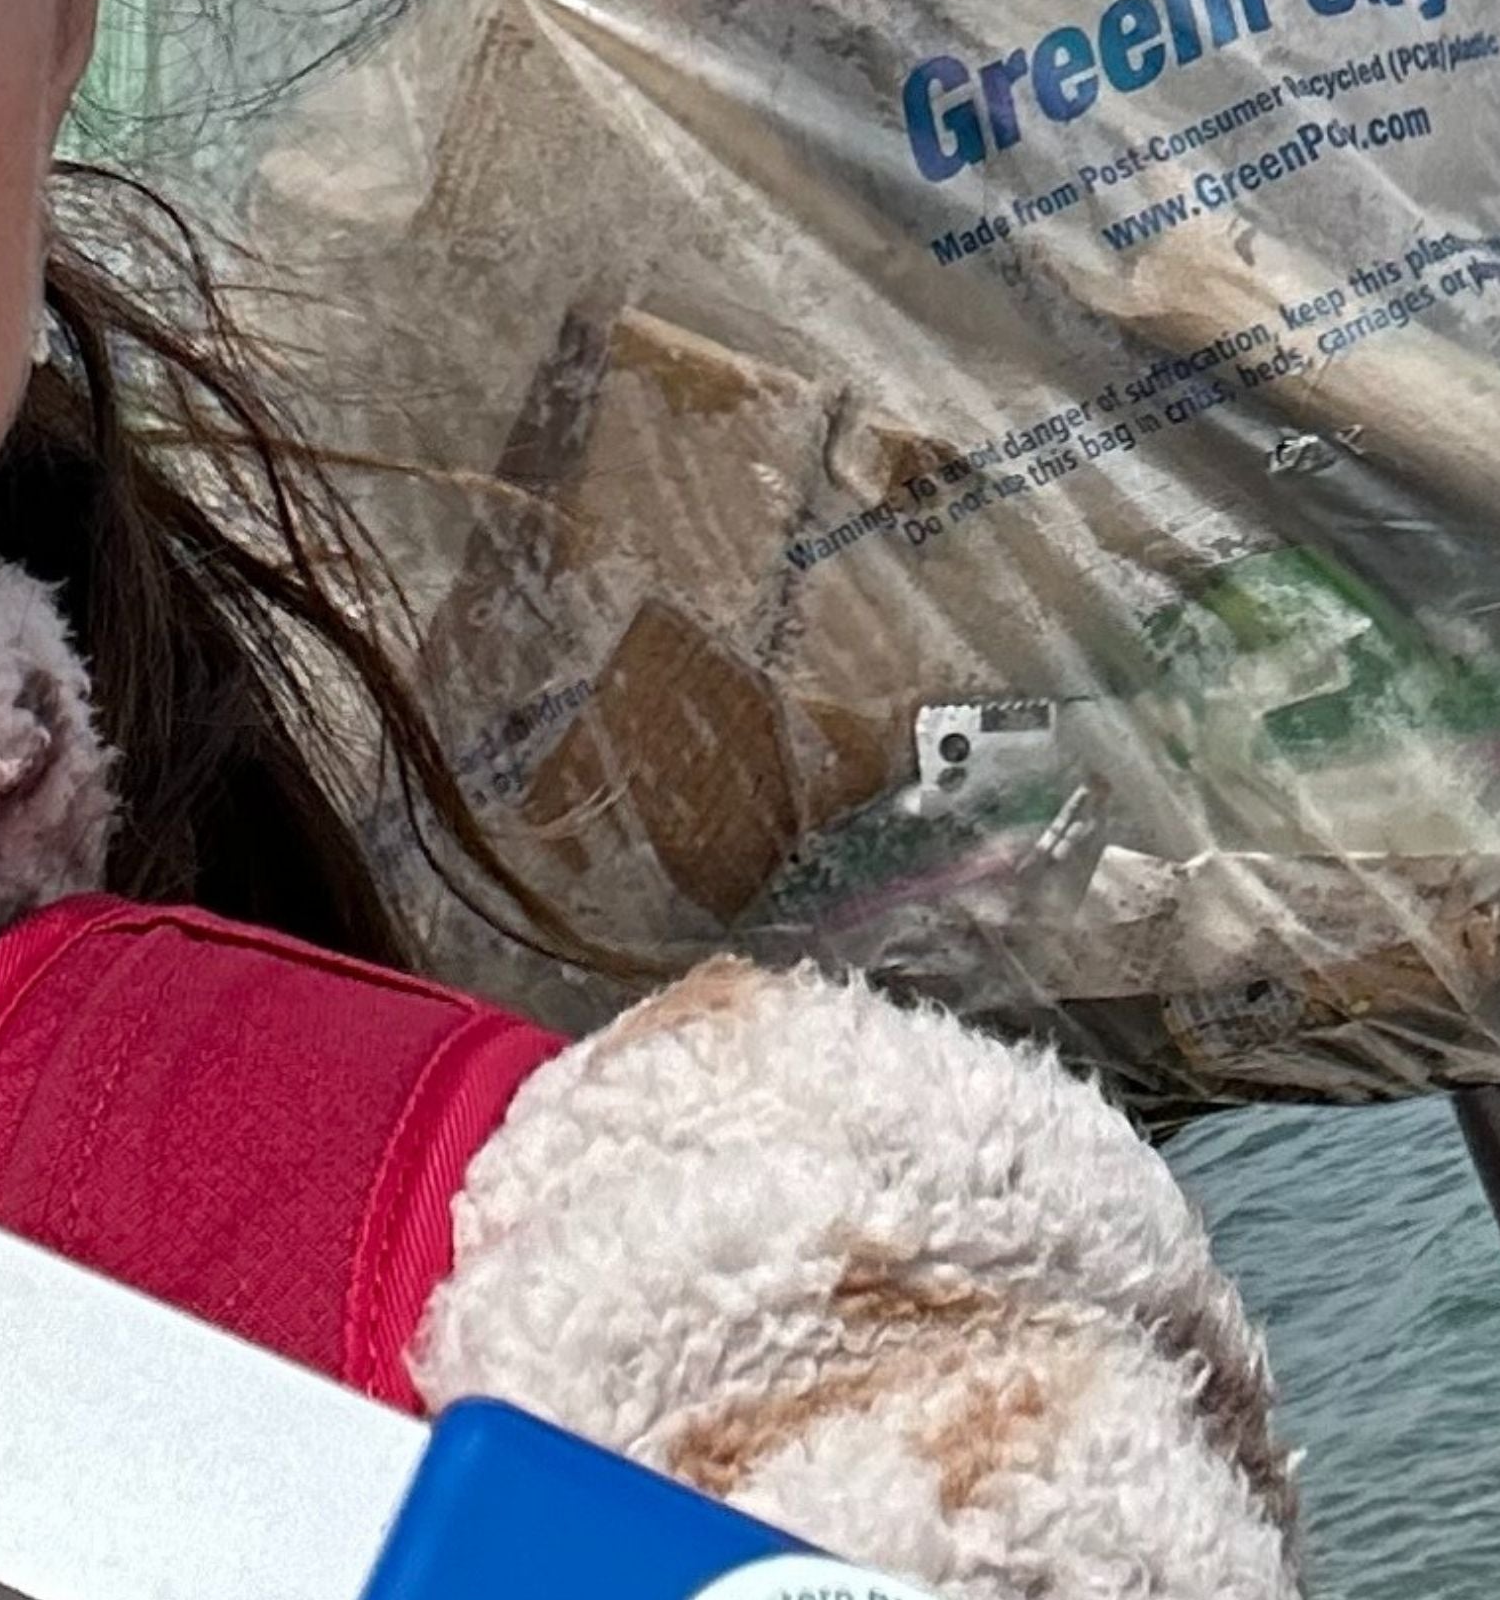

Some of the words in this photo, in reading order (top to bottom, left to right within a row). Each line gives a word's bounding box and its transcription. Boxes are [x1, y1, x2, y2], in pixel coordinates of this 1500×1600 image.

[931, 214, 1012, 267] Made
[1011, 182, 1080, 228] from
[1078, 83, 1284, 195] Post-Consumer
[903, 473, 938, 506] To
[940, 440, 1000, 485] avoid
[1002, 400, 1093, 461] danger
[1096, 384, 1123, 413] of
[1278, 287, 1346, 331] keep
[1349, 259, 1401, 299] this
[903, 513, 943, 548] Do
[1028, 447, 1078, 487] this
[1078, 421, 1137, 461] bag
[1316, 284, 1435, 356] carriages
